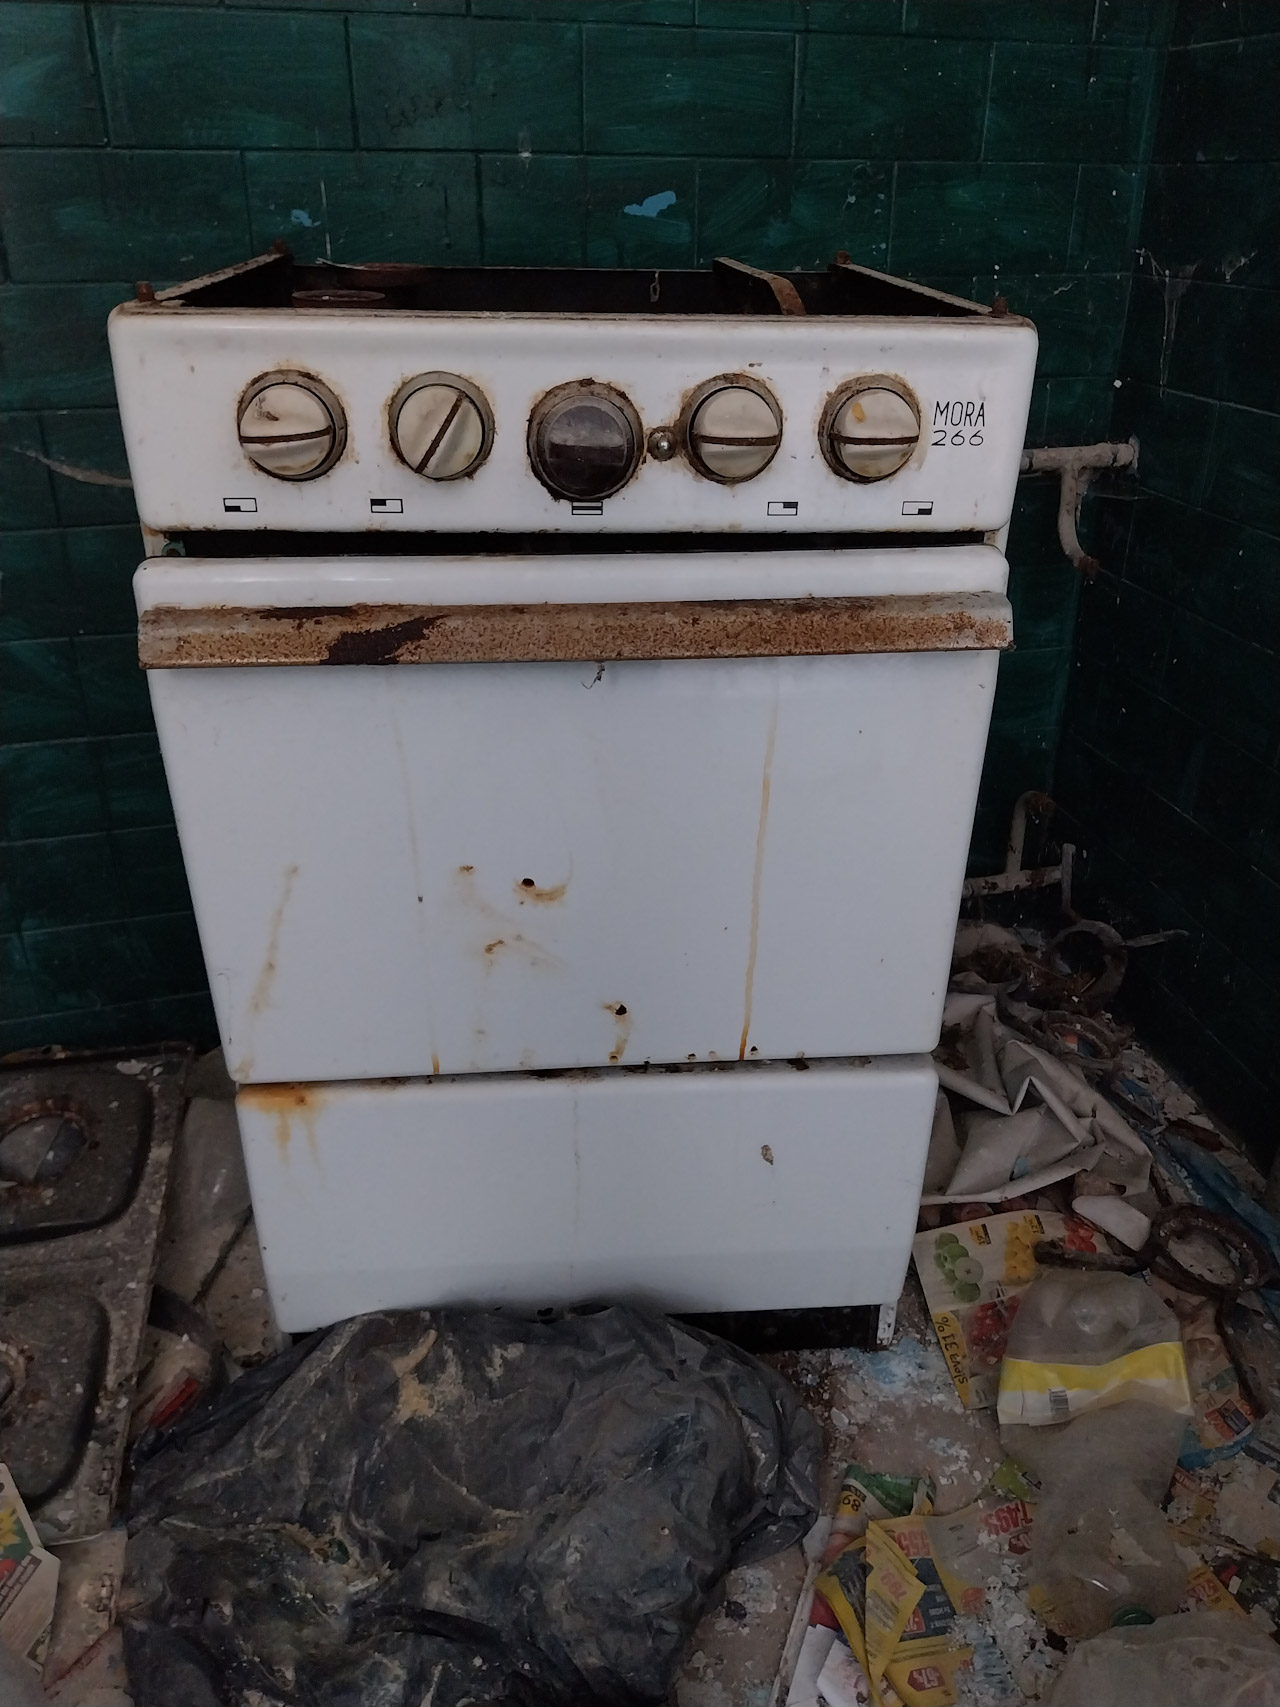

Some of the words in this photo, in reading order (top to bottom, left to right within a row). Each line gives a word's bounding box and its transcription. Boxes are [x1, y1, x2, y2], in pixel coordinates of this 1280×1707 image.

[933, 401, 985, 427] MORA
[931, 429, 984, 446] 266
[949, 1353, 968, 1384] sleva
